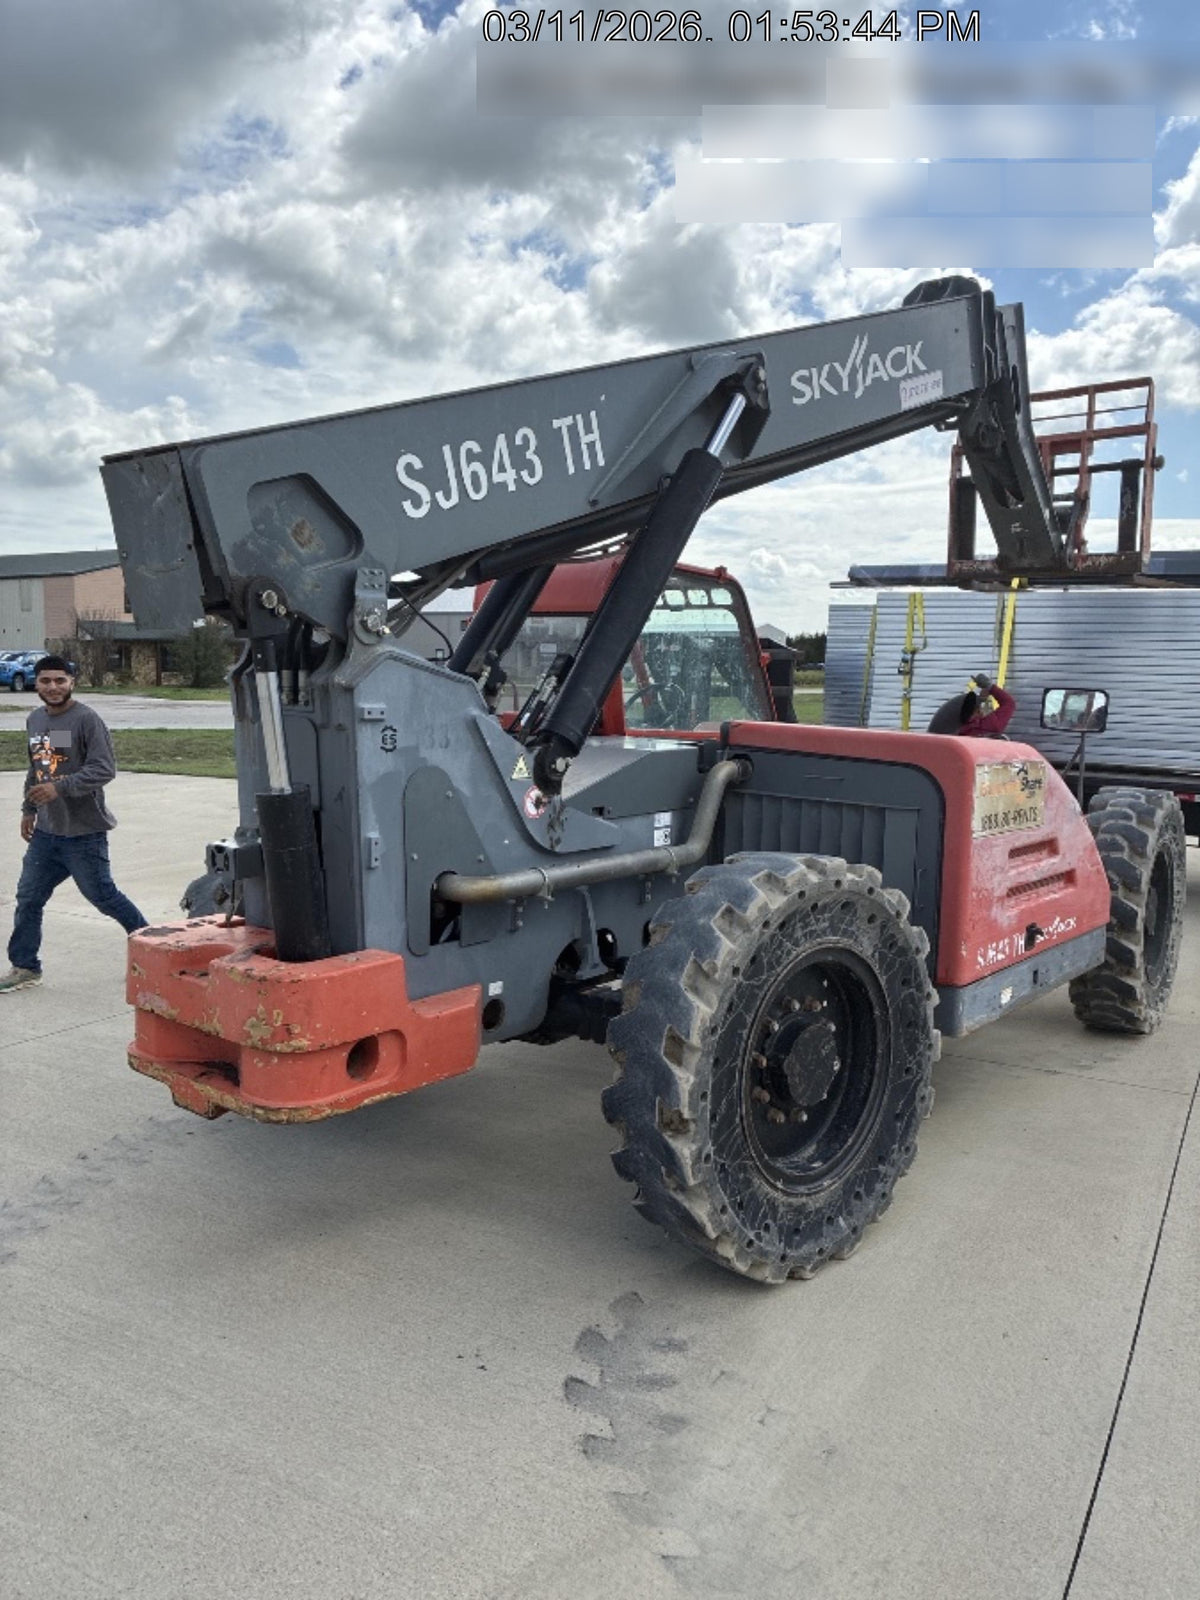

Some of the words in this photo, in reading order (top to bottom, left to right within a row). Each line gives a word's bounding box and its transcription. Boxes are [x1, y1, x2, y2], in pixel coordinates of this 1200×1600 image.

[790, 332, 927, 405] SKYJACK
[395, 426, 543, 519] SJ643
[552, 410, 605, 476] TH
